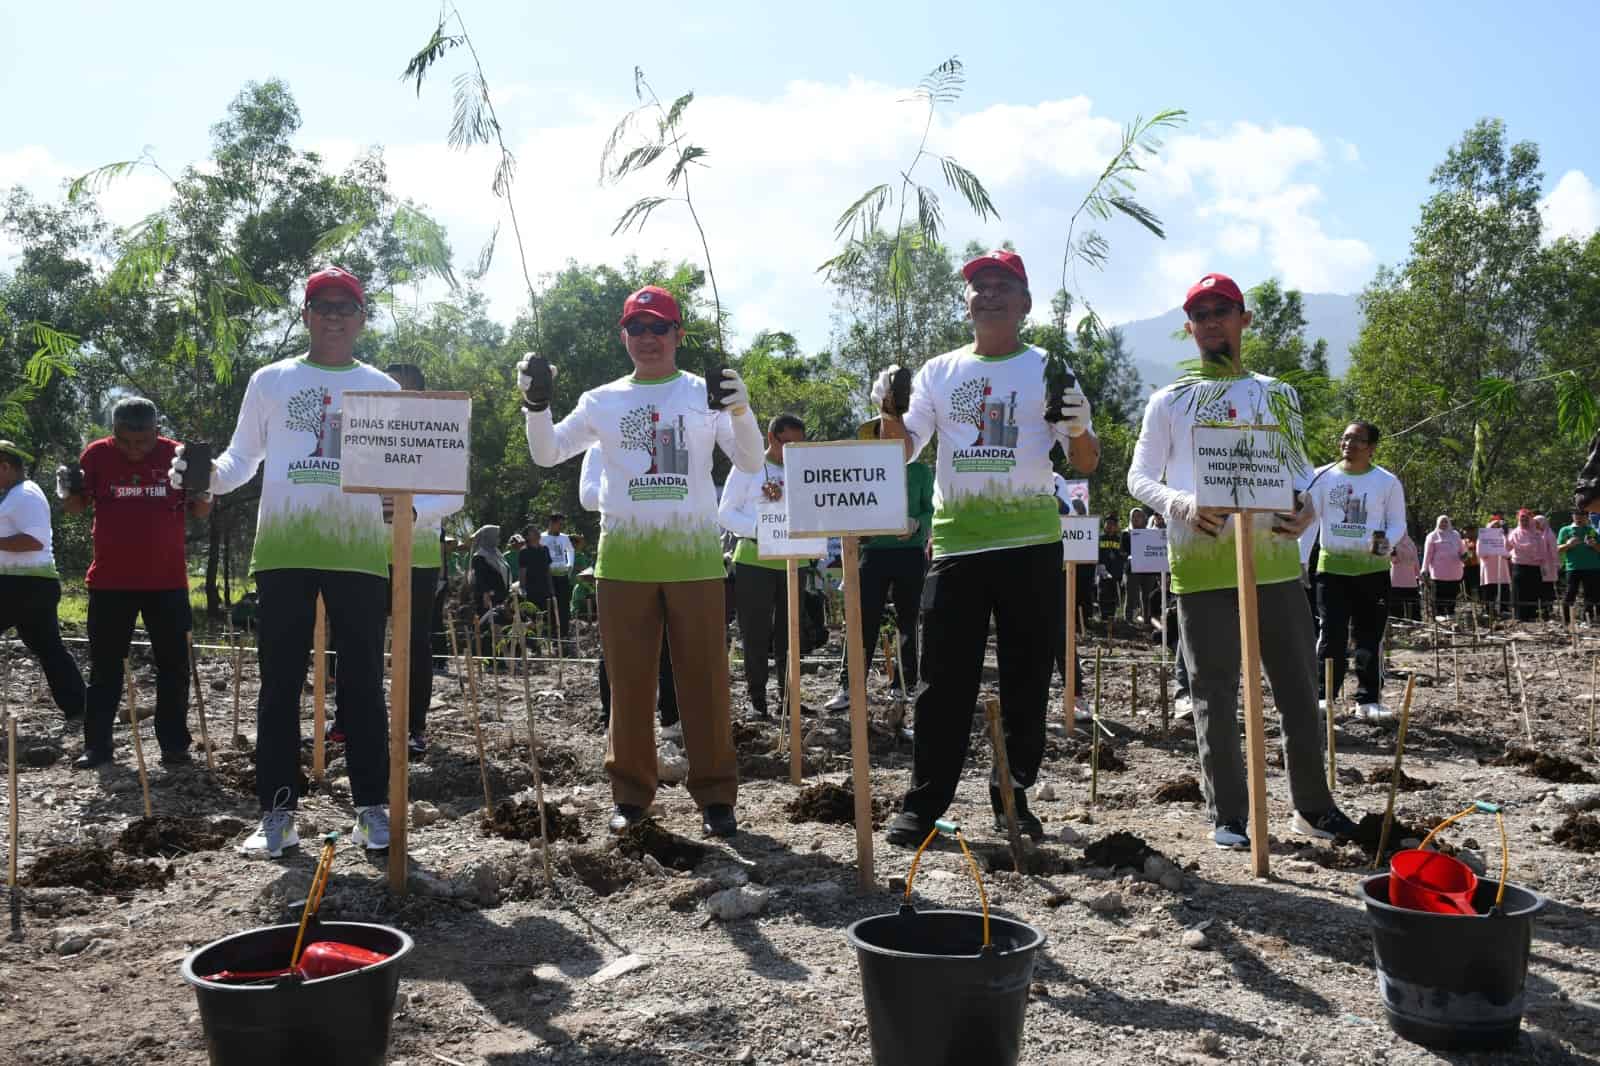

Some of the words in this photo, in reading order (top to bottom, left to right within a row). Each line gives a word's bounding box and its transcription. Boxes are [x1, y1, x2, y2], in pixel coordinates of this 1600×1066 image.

[350, 418, 384, 429] DINAS
[388, 419, 459, 432] KEHUTANAN
[344, 434, 397, 447] PROVINSI
[400, 436, 465, 449] SUMATERA
[952, 449, 1016, 459] KALIANDRA
[1198, 447, 1228, 457] DINAS
[384, 453, 423, 464] BARAT
[288, 459, 340, 471] KALIAND
[1208, 462, 1238, 472] HIDUP
[1240, 463, 1280, 473] PROVINSI
[803, 467, 886, 484] DIREKTUR
[629, 476, 688, 488] KALIANDRA
[1256, 479, 1284, 488] BARAT
[814, 492, 878, 507] UTAMA
[1062, 530, 1084, 540] AND
[1087, 530, 1092, 540] 1
